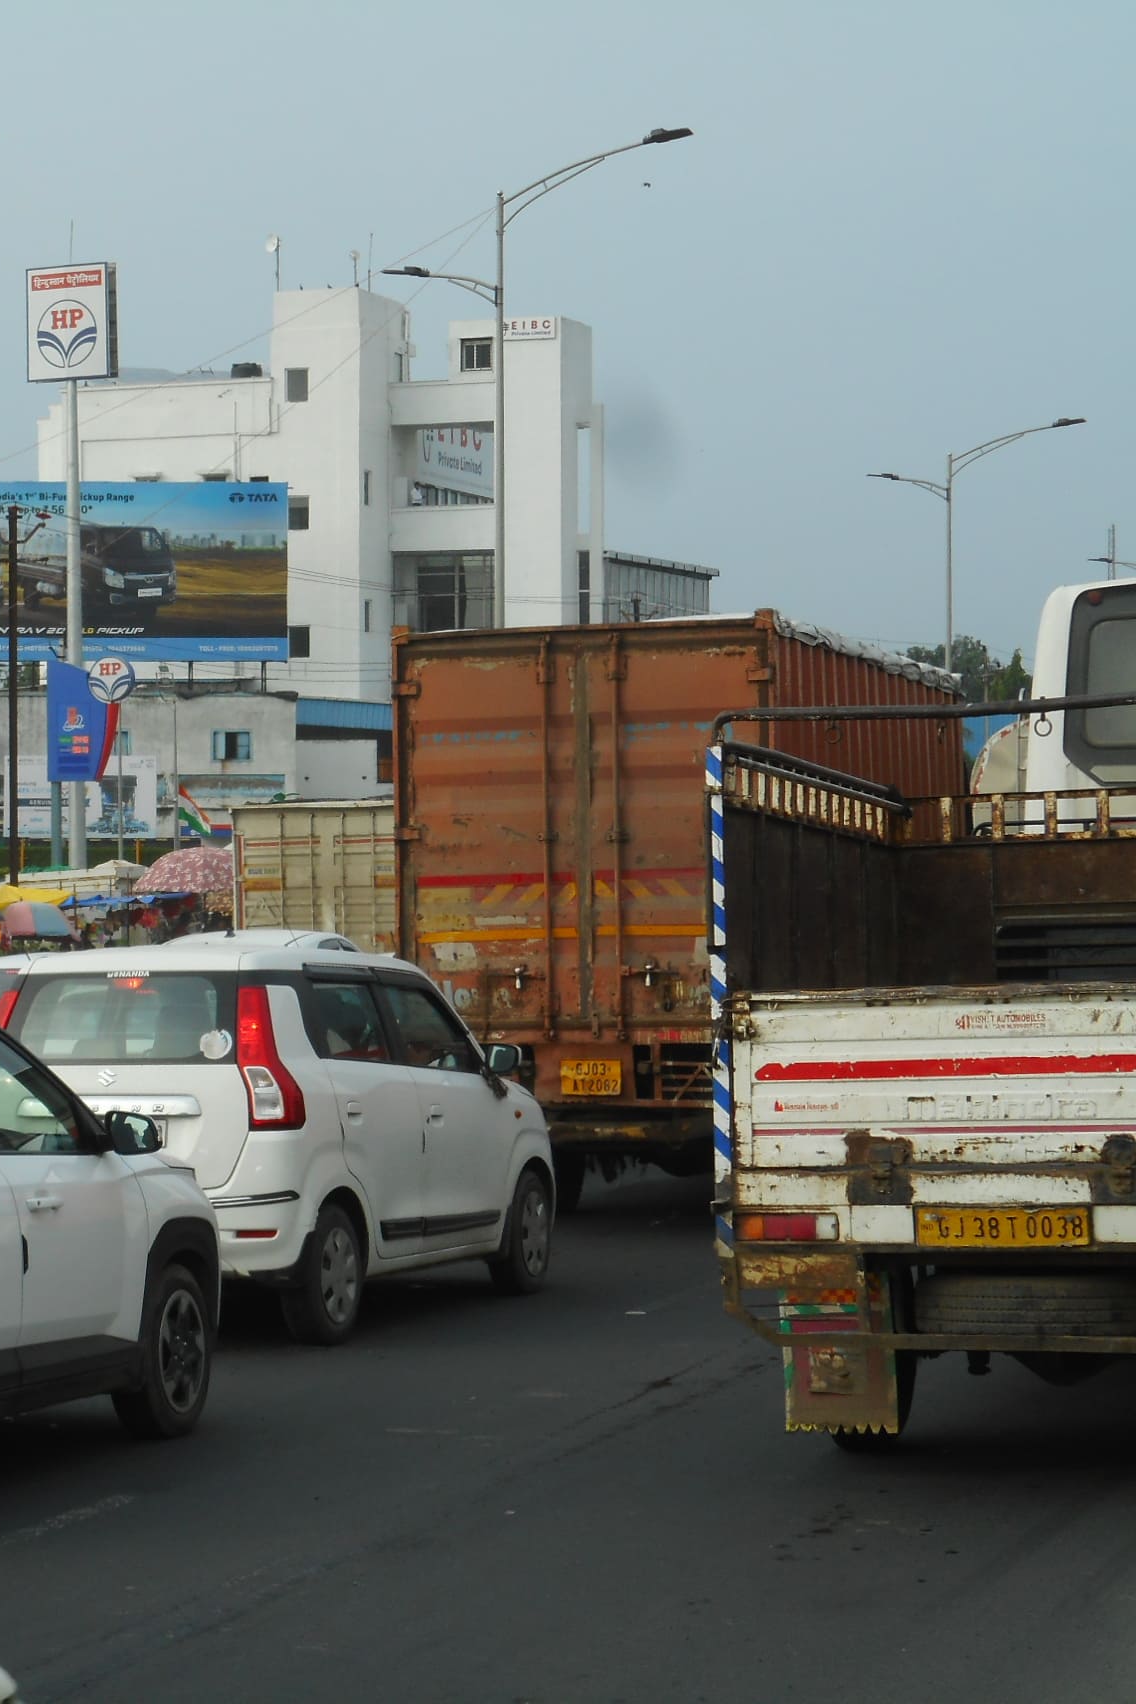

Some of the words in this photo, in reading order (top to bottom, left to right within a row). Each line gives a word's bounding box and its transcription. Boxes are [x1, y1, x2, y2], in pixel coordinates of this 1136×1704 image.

[51, 309, 84, 330] HP
[437, 451, 460, 470] Private
[460, 457, 483, 477] Limited
[80, 492, 105, 503] ickup
[106, 492, 135, 502] Range
[247, 493, 278, 503] TATA
[96, 627, 145, 635] PICKUP
[99, 662, 122, 676] HP
[996, 1014, 1046, 1022] AUTOMOBILES
[574, 1062, 607, 1077] GJ03
